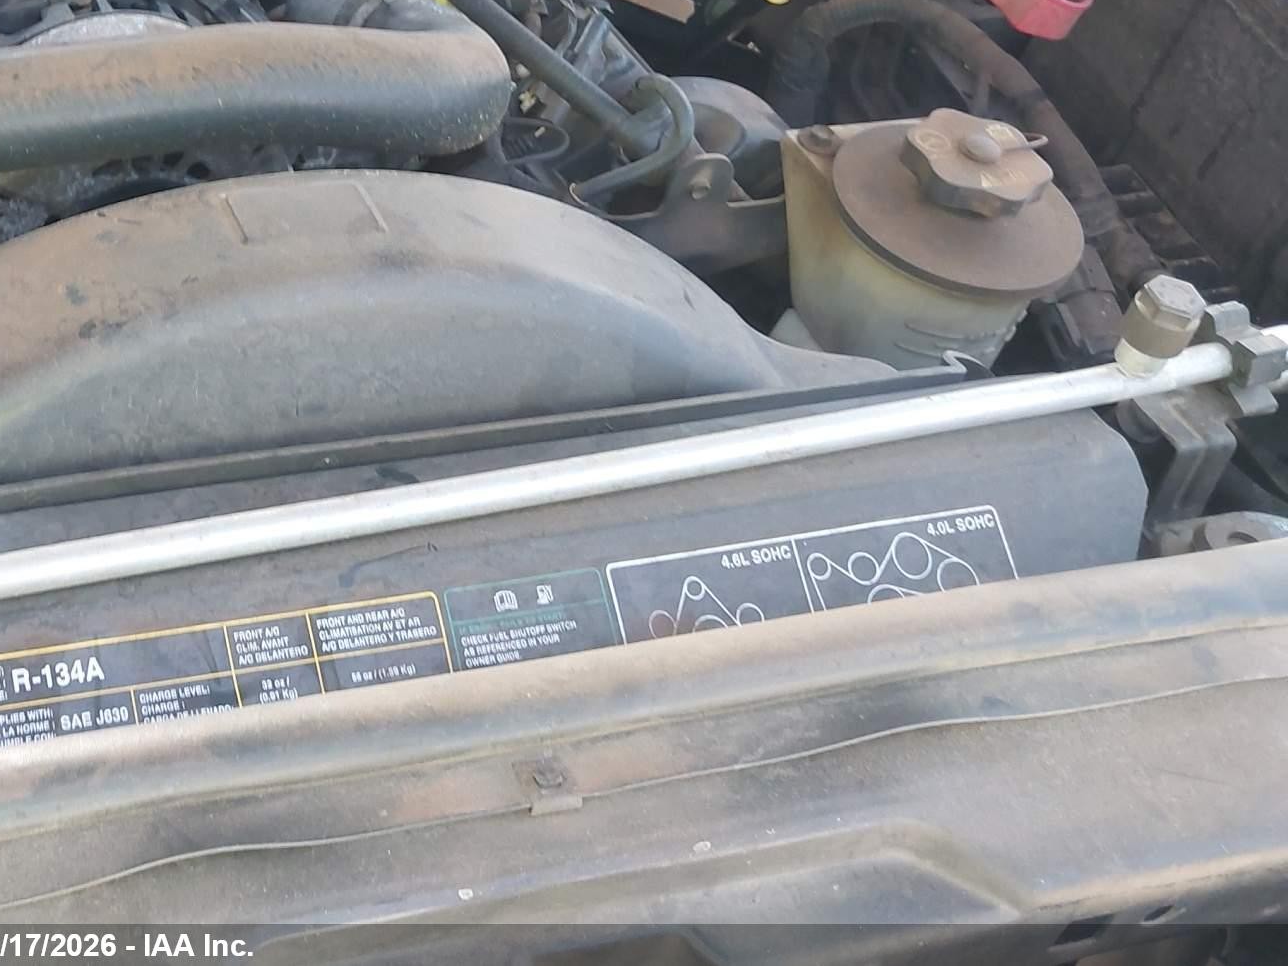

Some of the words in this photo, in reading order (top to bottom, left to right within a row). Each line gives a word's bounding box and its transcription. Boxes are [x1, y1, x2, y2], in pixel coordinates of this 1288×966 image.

[926, 519, 956, 536] 4.0L
[956, 513, 996, 532] SOHC
[751, 545, 792, 565] SOHC
[316, 616, 346, 630] FRONT
[347, 614, 364, 626] AND
[365, 610, 389, 623] REAR
[233, 628, 263, 642] FRONT
[261, 636, 289, 650] AVANT
[338, 634, 388, 650] DELANTERO
[389, 632, 395, 643] Y
[461, 634, 489, 647] CHECK
[490, 631, 510, 644] FUEL
[509, 624, 546, 640] SHUTOFF
[547, 620, 577, 633] SWITCH
[476, 639, 527, 656] REFERENCED
[528, 637, 537, 647] IN
[538, 633, 561, 646] YOUR
[255, 645, 309, 664] DELANTERO
[465, 655, 496, 669] OWNER
[12, 657, 105, 694] R-134A
[139, 689, 178, 704] CHARGE
[141, 700, 180, 716] CHARGE
[16, 720, 49, 736] NORME
[60, 711, 93, 731] SAE
